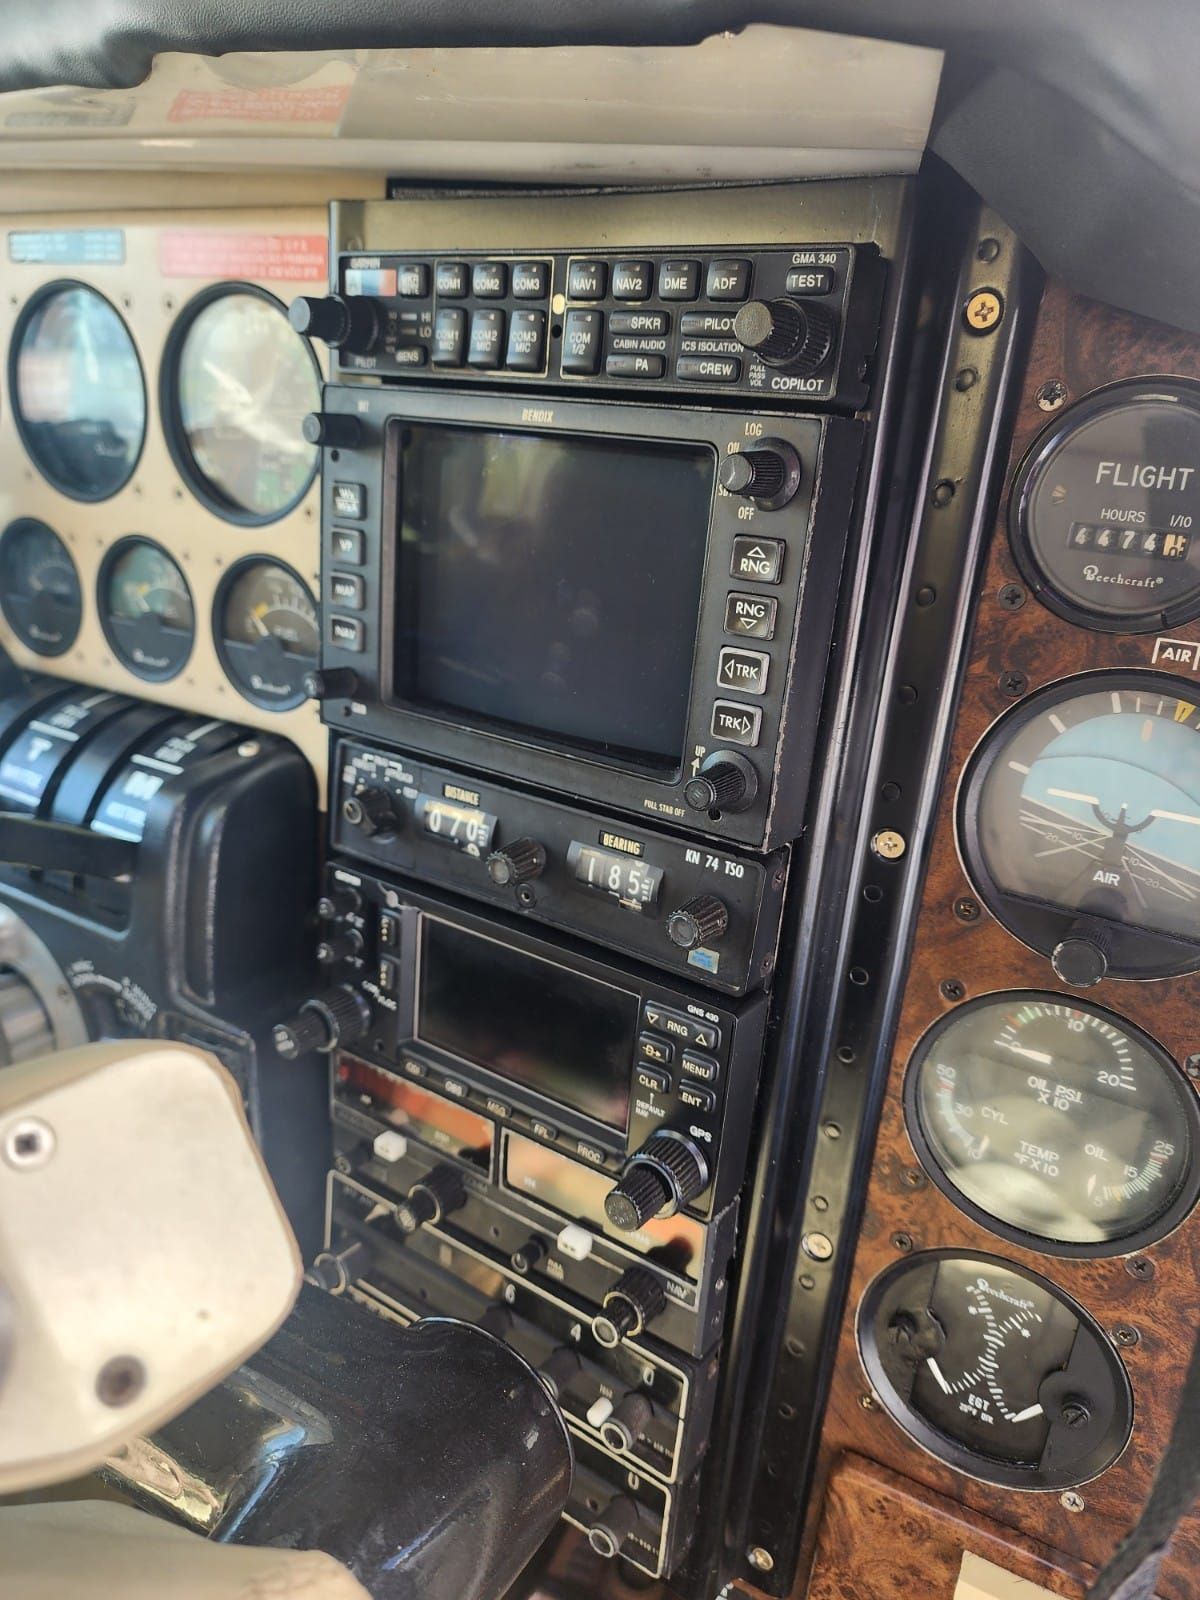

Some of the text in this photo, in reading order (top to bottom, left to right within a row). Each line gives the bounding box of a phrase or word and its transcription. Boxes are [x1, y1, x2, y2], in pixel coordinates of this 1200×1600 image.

[792, 253, 837, 264] GMA 340
[438, 278, 461, 290] COM1
[475, 278, 500, 290] COM2
[514, 278, 540, 290] COM3
[572, 278, 597, 291] NAV1
[616, 277, 642, 291] NAV2
[664, 277, 688, 290] DME
[712, 277, 737, 290] ADF
[790, 274, 825, 289] TEST
[630, 316, 661, 330] SPKR
[511, 331, 537, 343] COM3
[569, 332, 591, 345] COM
[613, 338, 666, 350] CABIN AUDIO
[515, 342, 531, 353] MIC
[681, 340, 745, 353] ICS ISOLATION
[635, 358, 649, 371] PA
[700, 361, 733, 376] CREW
[771, 377, 825, 391] COPILOT
[744, 422, 762, 436] LOG
[727, 442, 740, 454] ON
[1095, 461, 1195, 491] FLIGHT
[738, 507, 755, 520] OFF
[1100, 508, 1146, 523] HOURS
[740, 558, 771, 574] RNG
[735, 601, 765, 618] RNG
[1161, 647, 1192, 663] AIR
[736, 663, 759, 680] TRK
[719, 714, 742, 730] TRK
[695, 745, 706, 758] UP
[603, 833, 641, 855] BEARING
[685, 849, 744, 878] KN 74 TSO
[587, 857, 641, 895] 185
[1092, 870, 1120, 886] AIR
[667, 1020, 688, 1037] RNG
[1067, 1019, 1085, 1032] 10
[682, 1060, 710, 1078] MENU
[639, 1074, 658, 1090] CLR
[1027, 1075, 1051, 1093] OIL
[1096, 1070, 1121, 1087] 20
[681, 1093, 702, 1107] ENT
[1053, 1096, 1070, 1111] 10
[955, 1102, 974, 1118] 30
[981, 1106, 1009, 1125] CYL
[689, 1125, 713, 1142] GPS
[1019, 1140, 1060, 1162] TEMP
[1084, 1143, 1109, 1162] OIL
[1153, 1140, 1175, 1156] 25
[1124, 1164, 1138, 1178] 15
